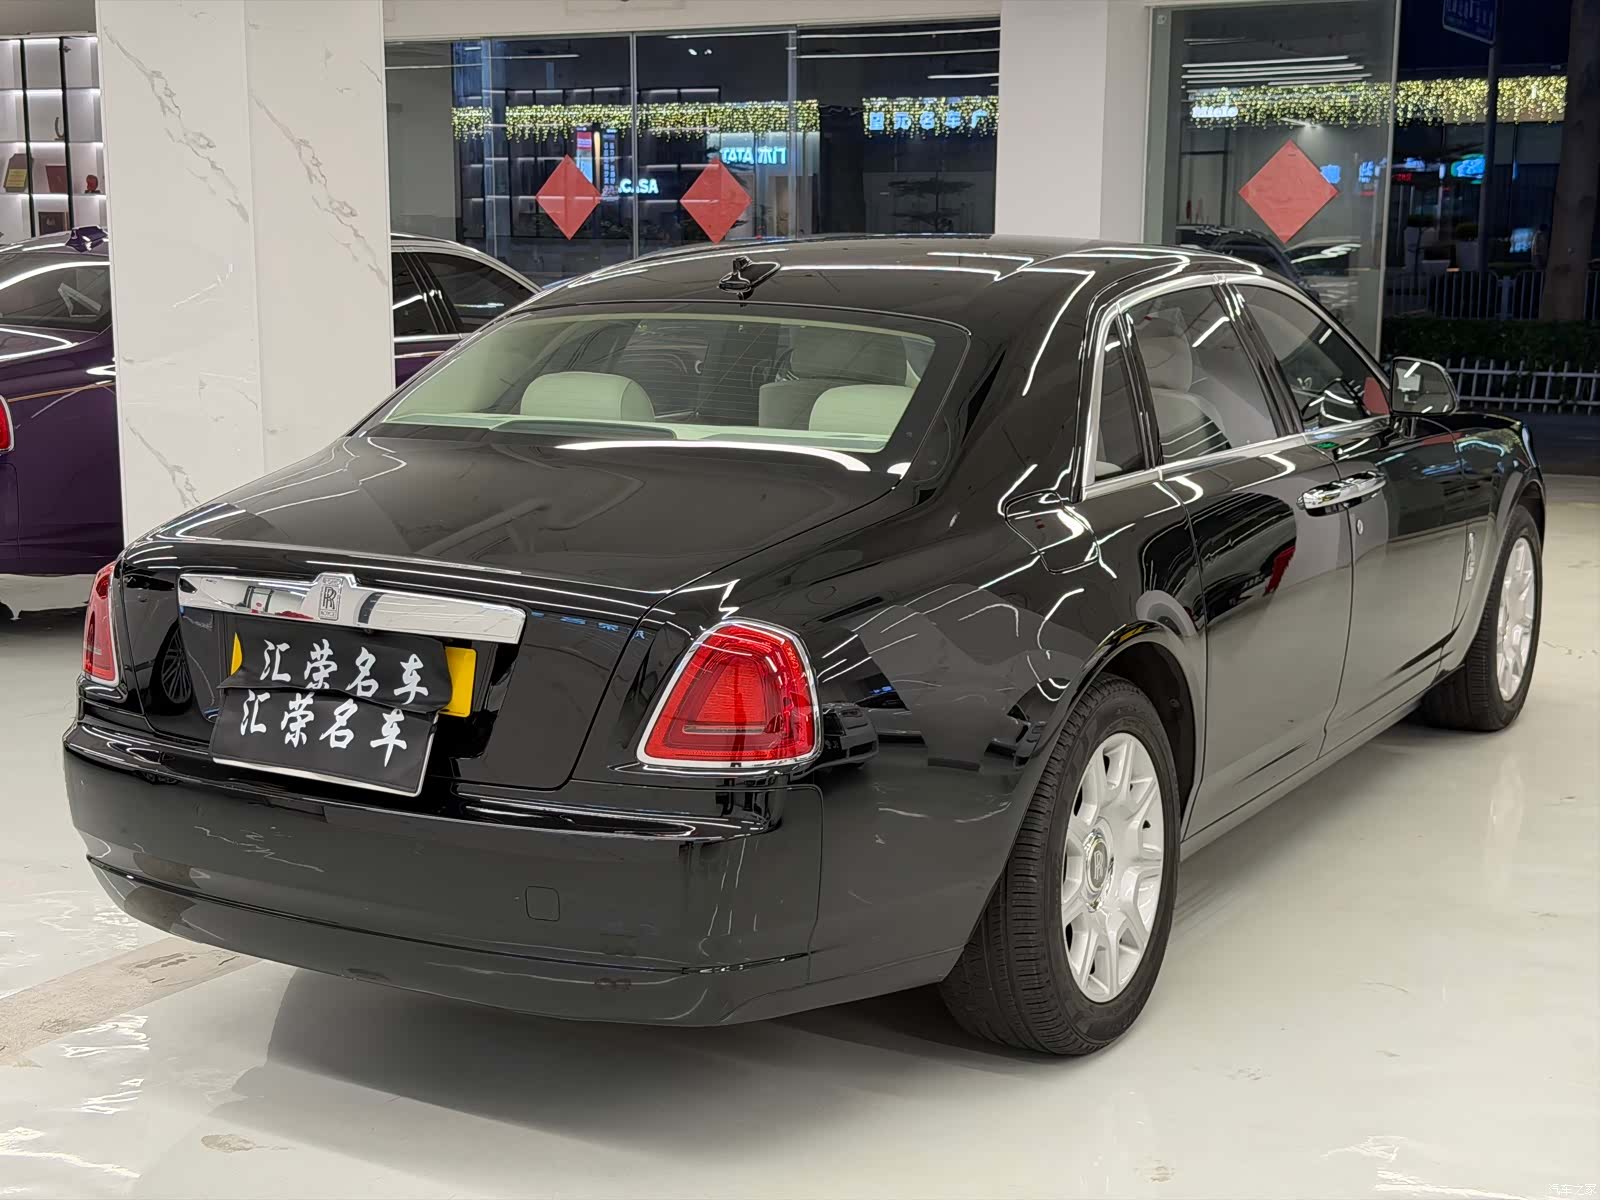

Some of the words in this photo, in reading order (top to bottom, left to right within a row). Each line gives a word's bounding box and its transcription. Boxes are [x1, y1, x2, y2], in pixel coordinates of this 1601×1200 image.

[260, 638, 429, 705] 汇荣名车
[240, 689, 407, 767] 汇荣名车
